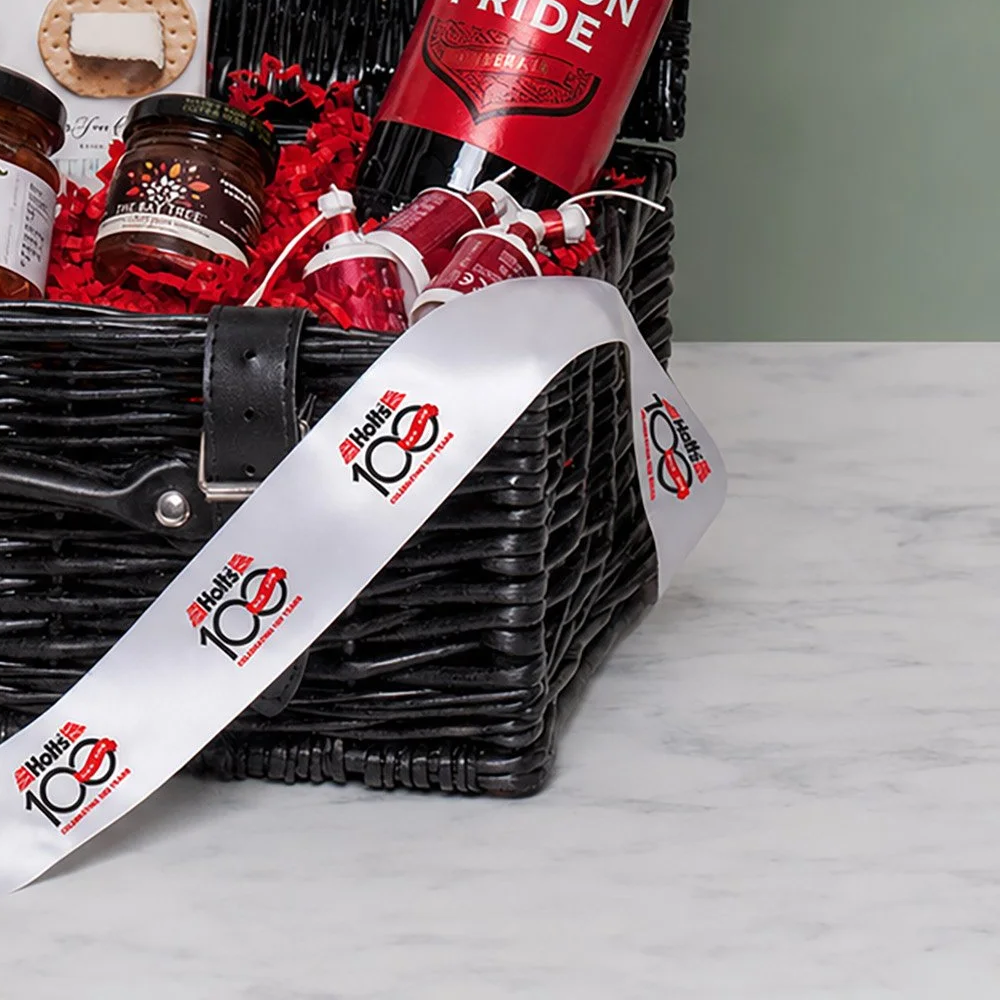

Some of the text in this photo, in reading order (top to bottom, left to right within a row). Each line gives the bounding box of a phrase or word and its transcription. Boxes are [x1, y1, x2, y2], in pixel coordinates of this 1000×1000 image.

[351, 404, 440, 498] 100
[200, 567, 288, 661] 100
[25, 737, 117, 828] 100
